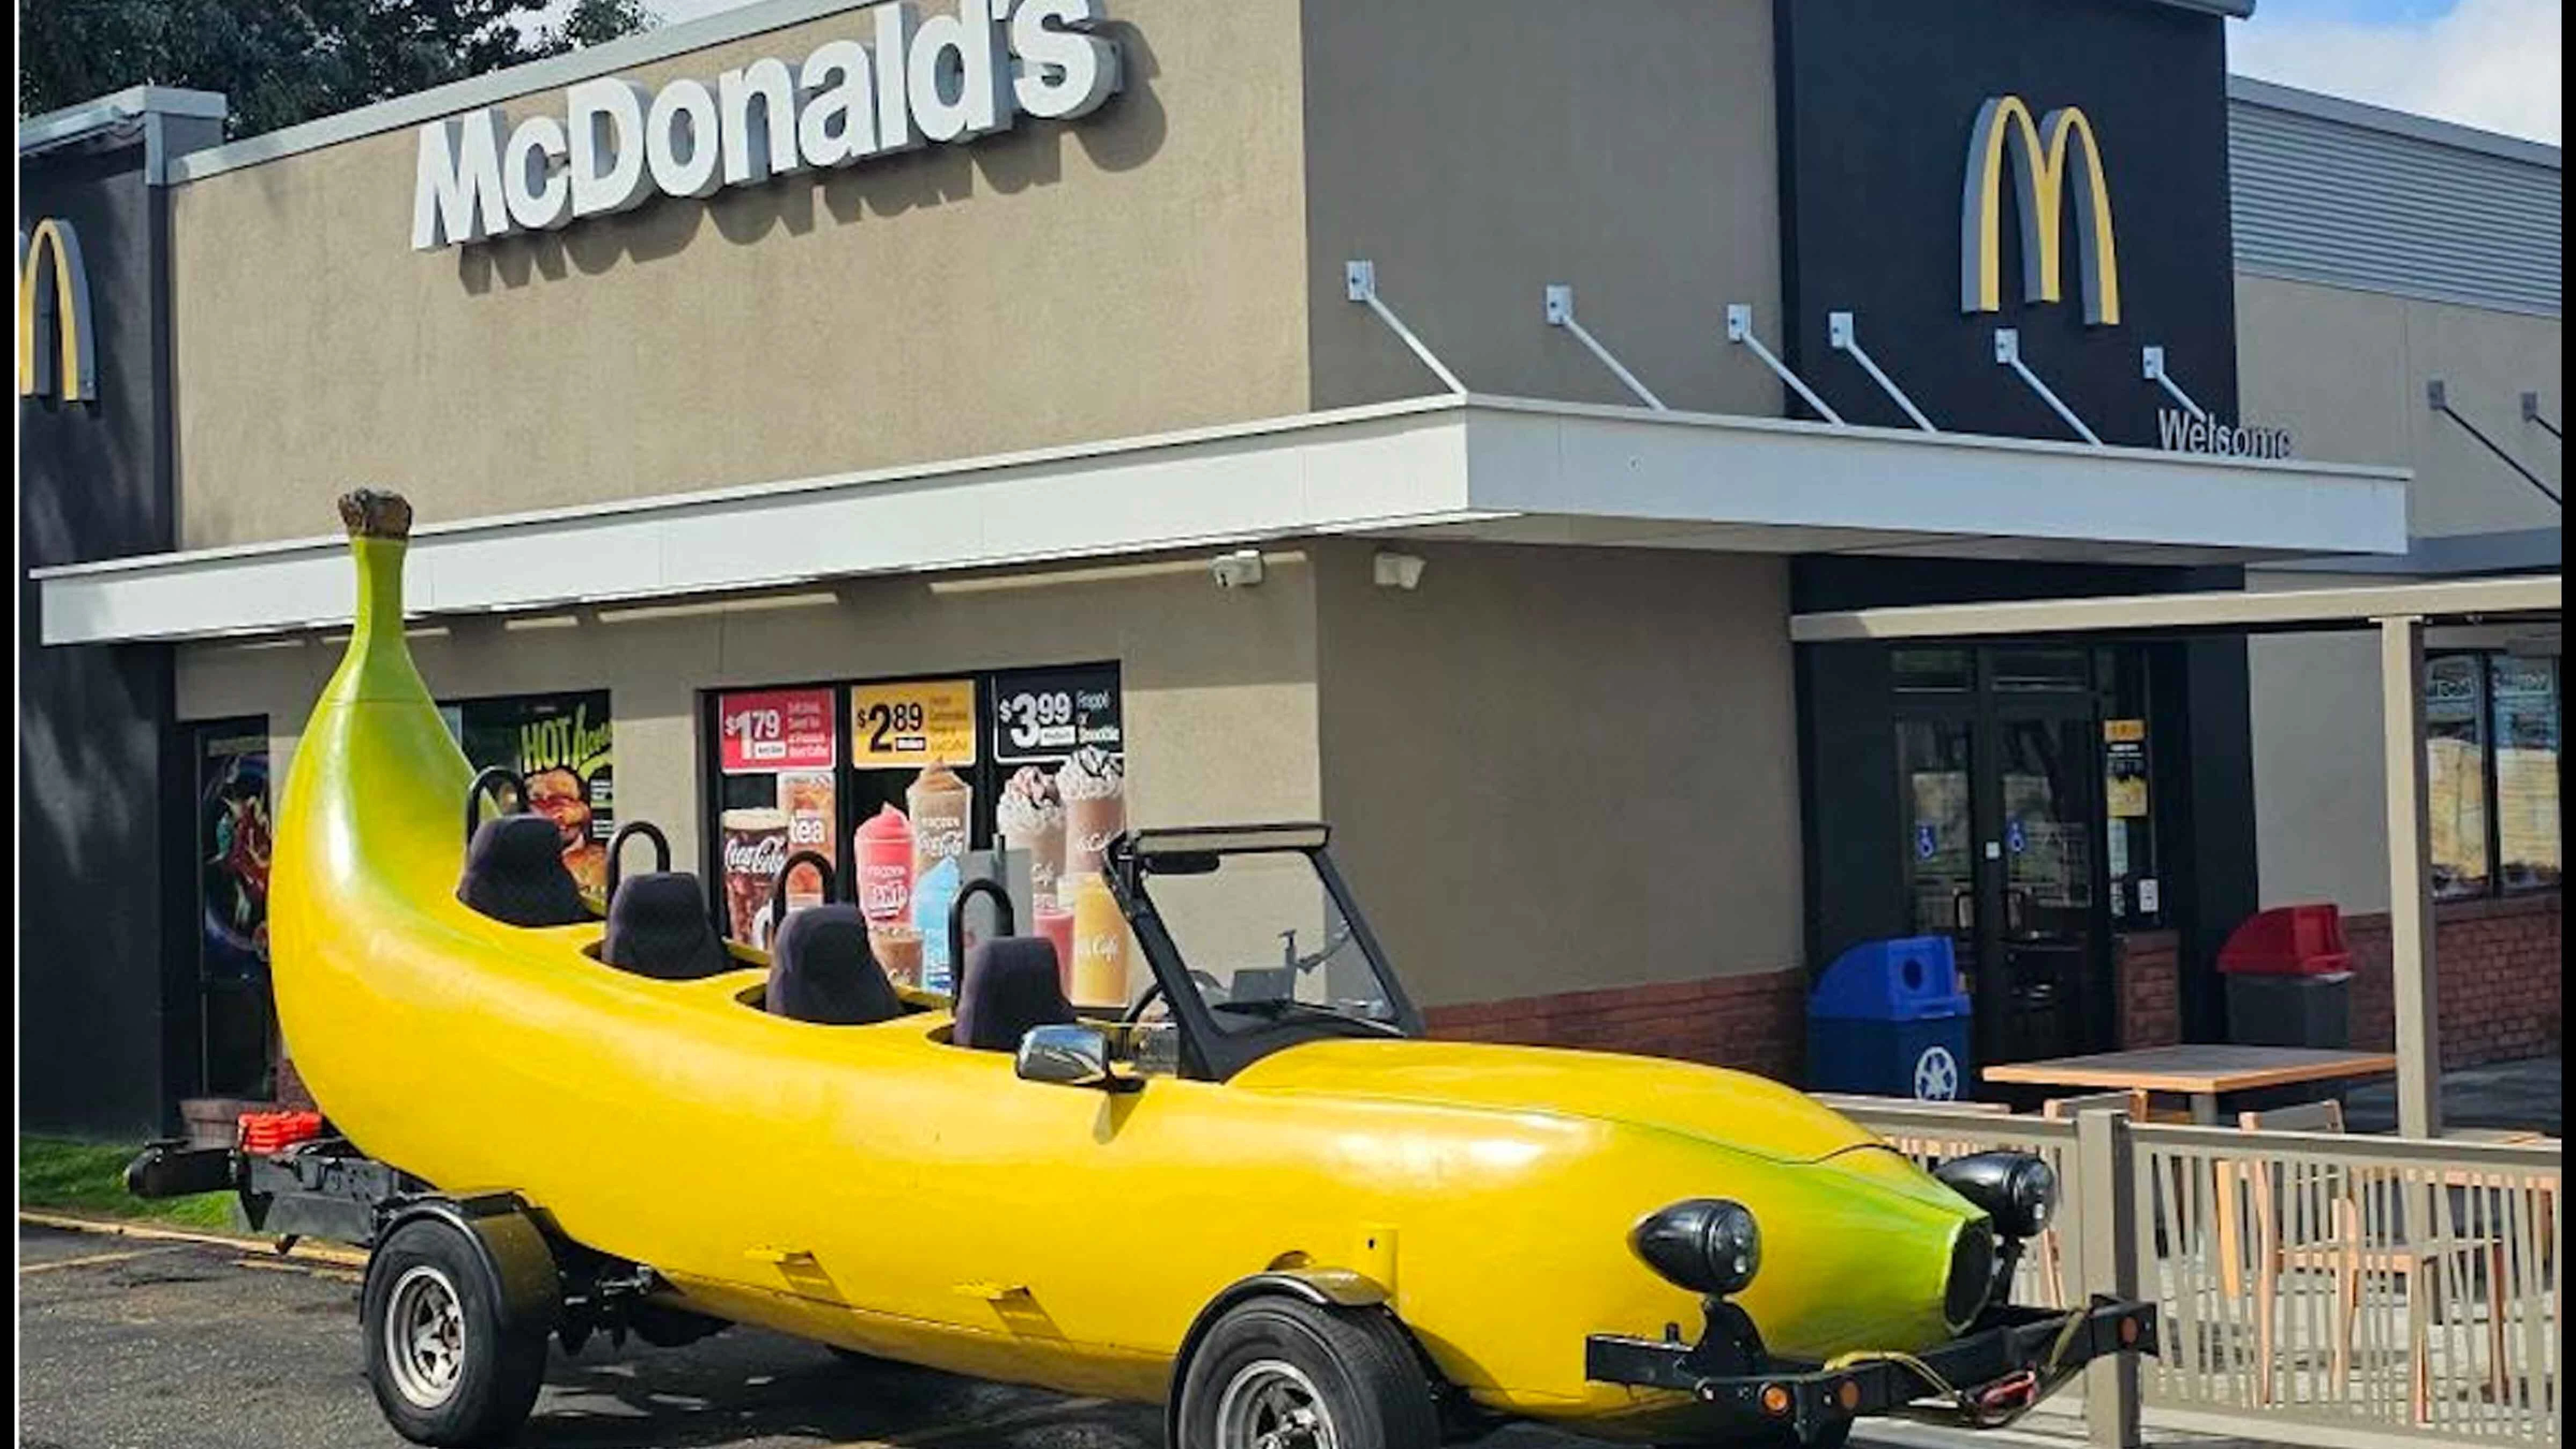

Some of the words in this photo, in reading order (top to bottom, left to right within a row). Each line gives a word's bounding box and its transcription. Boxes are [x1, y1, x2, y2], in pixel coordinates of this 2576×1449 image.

[409, 0, 1119, 251] McDonald's
[521, 717, 572, 773] HOT
[790, 816, 825, 843] tea
